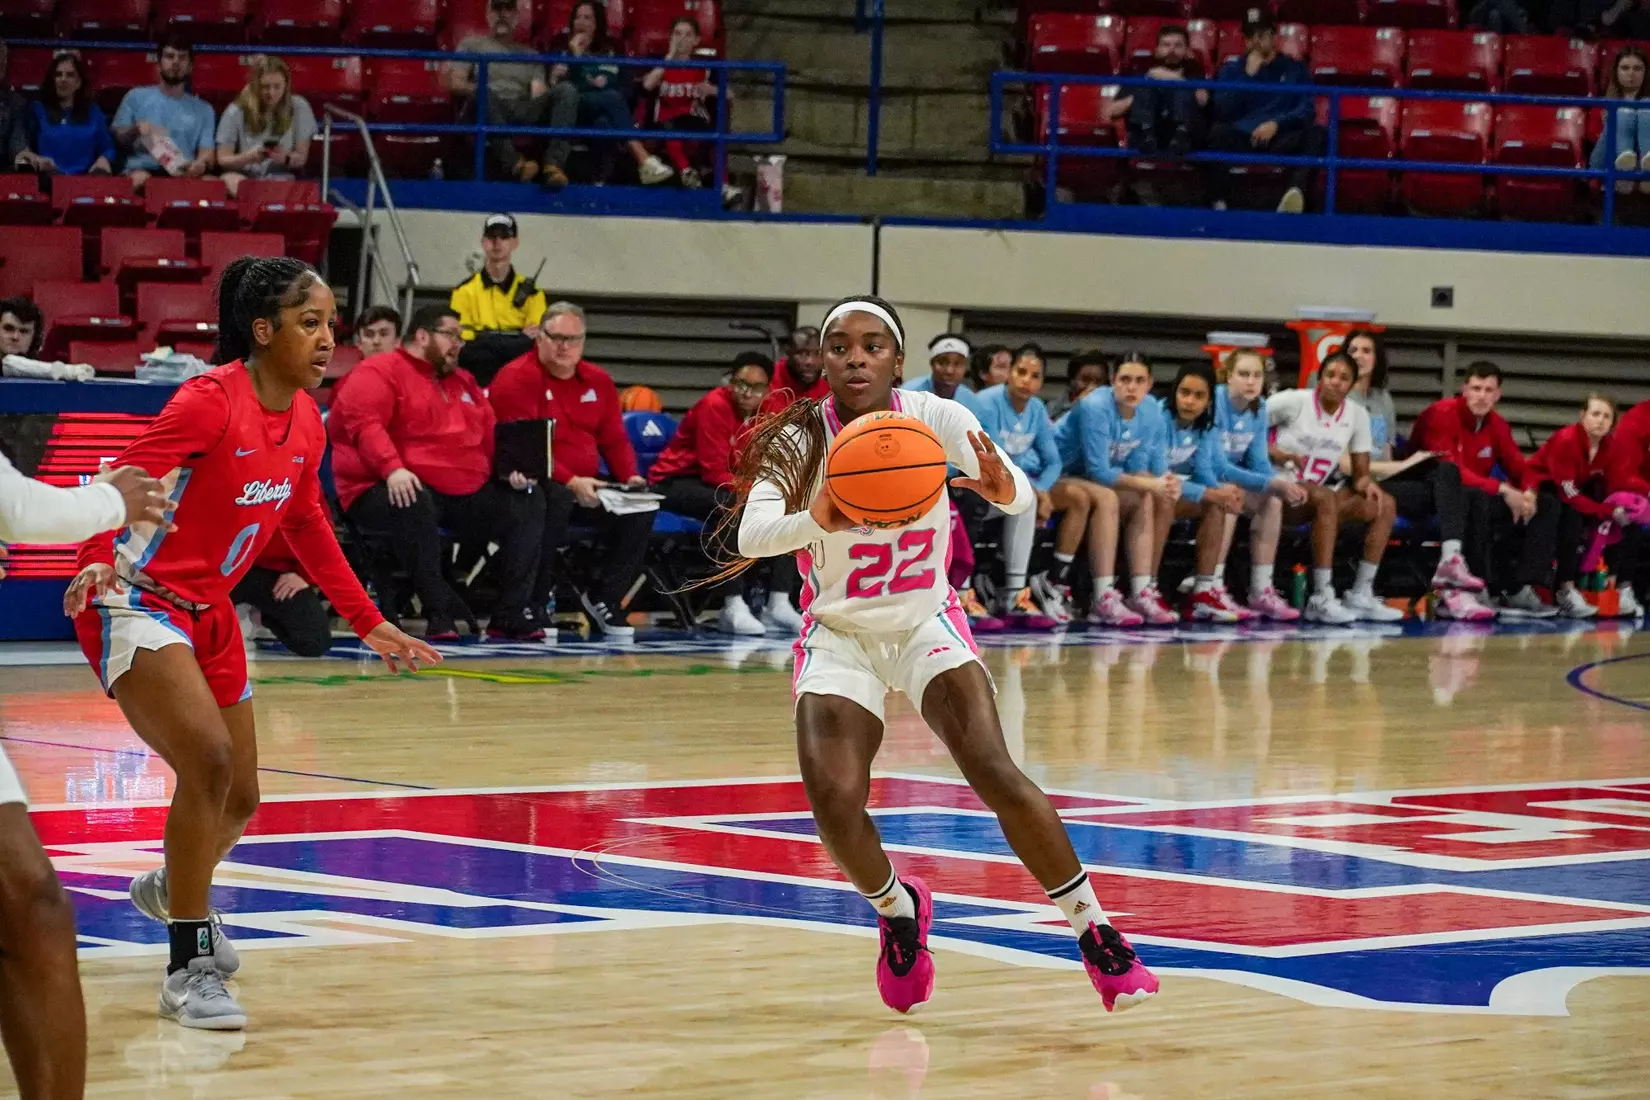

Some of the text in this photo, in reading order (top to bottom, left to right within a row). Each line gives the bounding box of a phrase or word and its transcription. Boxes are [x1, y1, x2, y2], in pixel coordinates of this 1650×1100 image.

[235, 477, 292, 511] Liberty
[220, 522, 260, 577] 0
[845, 527, 936, 600] 22
